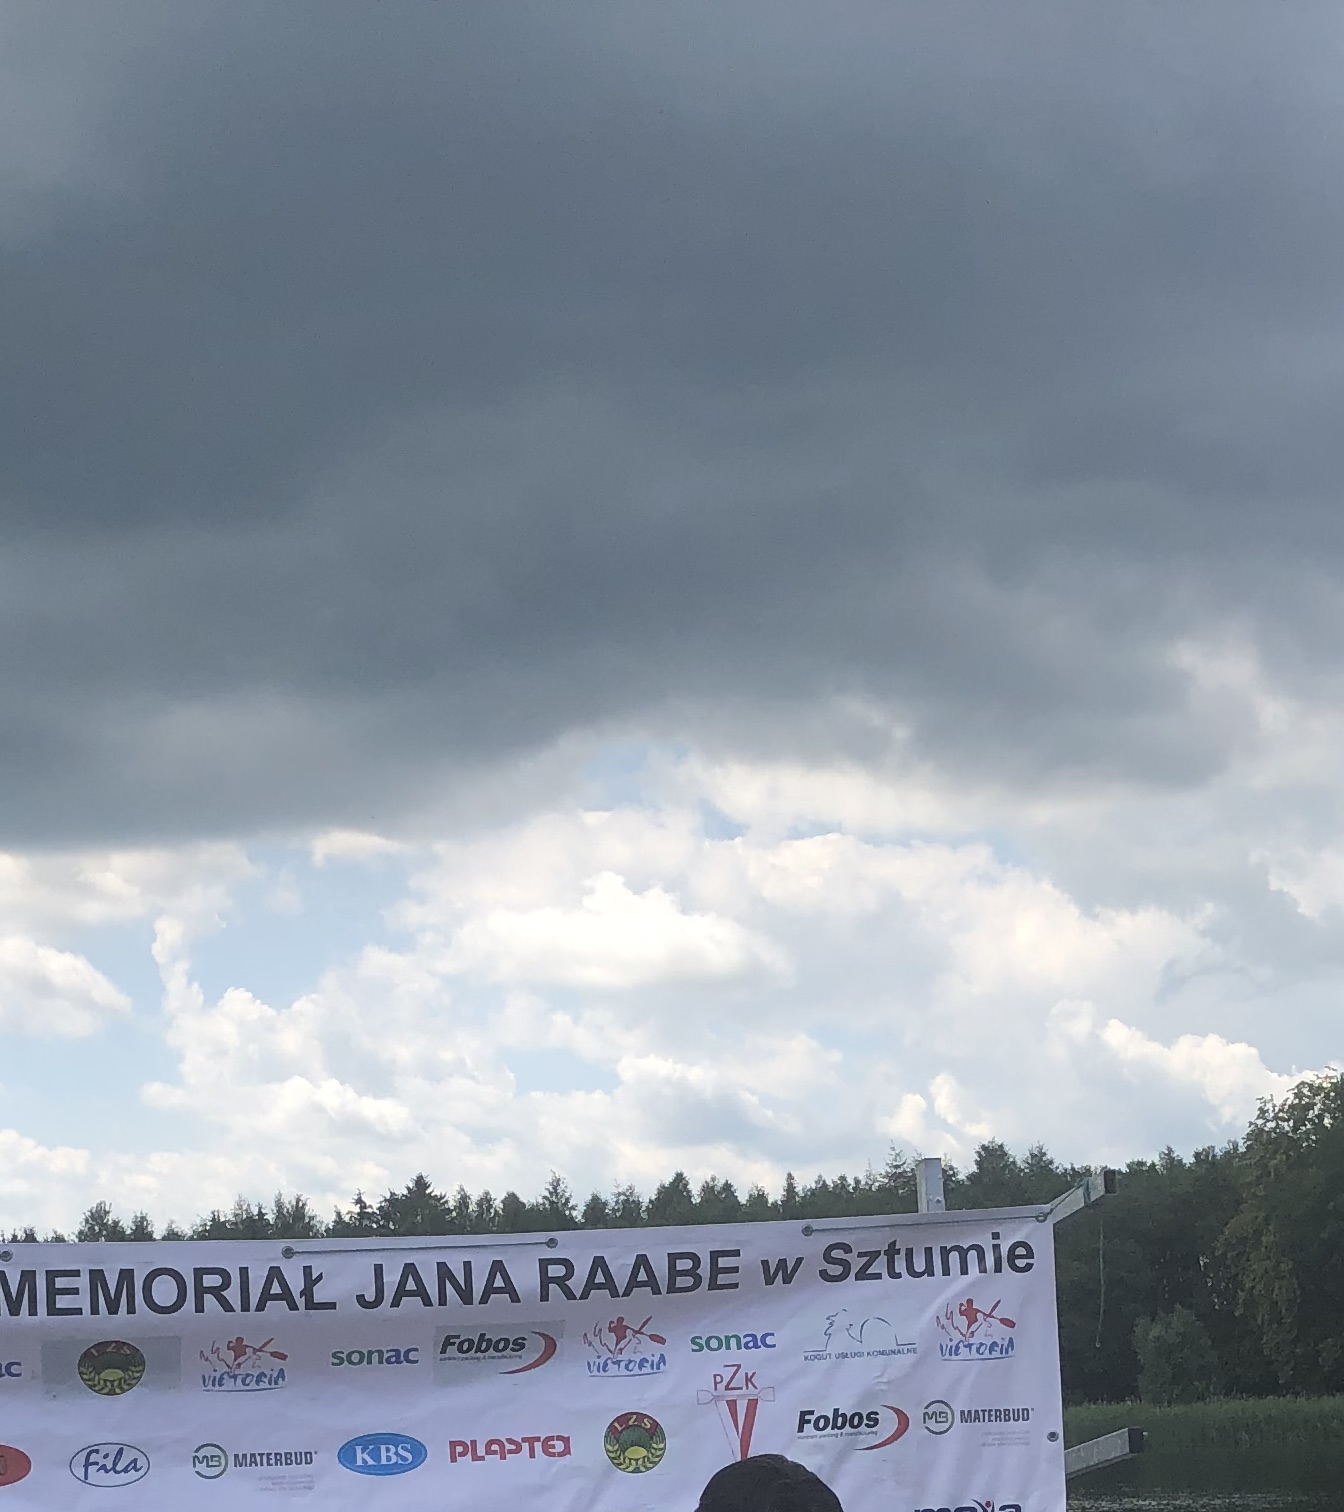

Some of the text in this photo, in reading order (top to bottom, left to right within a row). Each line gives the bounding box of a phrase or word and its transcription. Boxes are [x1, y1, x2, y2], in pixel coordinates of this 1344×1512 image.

[355, 1259, 522, 1310] JANA
[538, 1248, 741, 1303] RAABE
[760, 1256, 804, 1287] w
[818, 1231, 1034, 1283] Sztumie
[439, 1332, 528, 1355] Fobos
[690, 1331, 776, 1353] sonac
[330, 1347, 420, 1367] sonac
[803, 1352, 832, 1362] KOGUT
[712, 1364, 759, 1391] PZK
[613, 1414, 653, 1432] LZS
[796, 1407, 880, 1433] Fobos
[959, 1408, 1030, 1424] MATERBUD
[82, 1447, 144, 1481] Fila
[233, 1451, 314, 1468] MATERBUD
[354, 1444, 414, 1467] KBS
